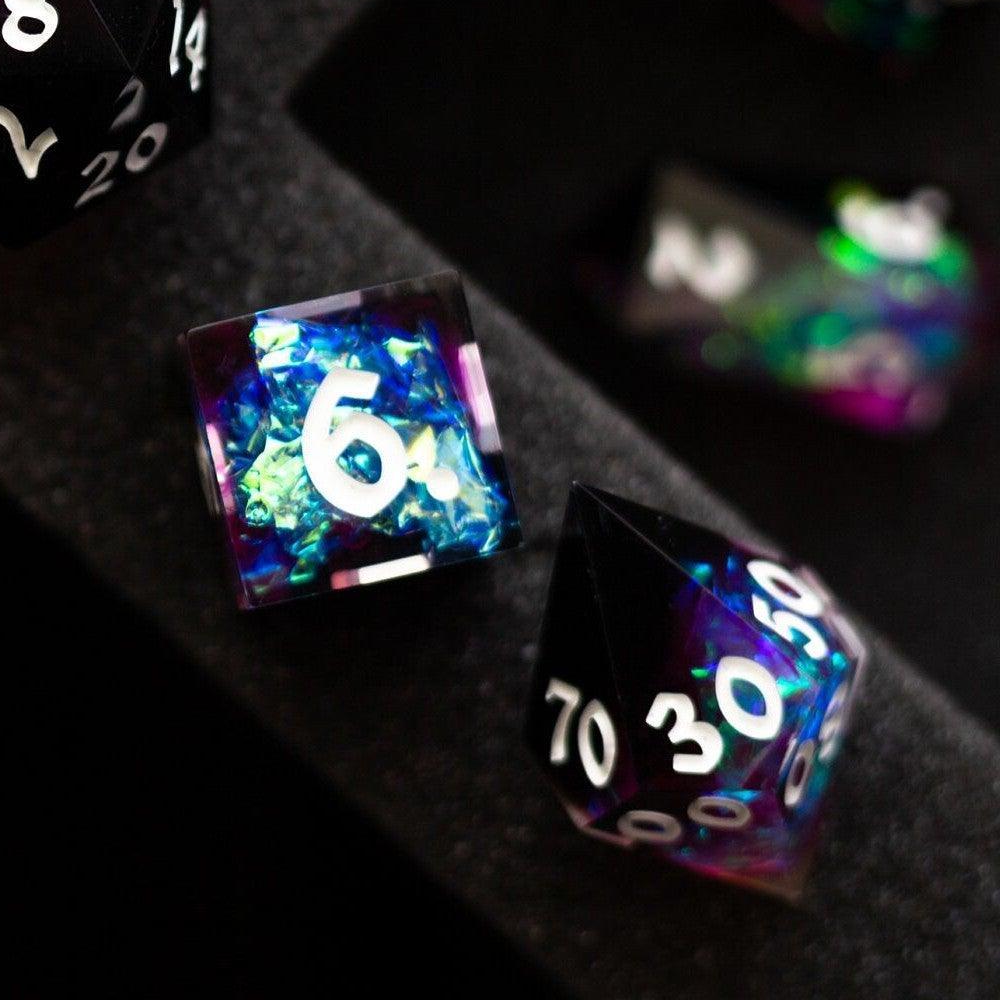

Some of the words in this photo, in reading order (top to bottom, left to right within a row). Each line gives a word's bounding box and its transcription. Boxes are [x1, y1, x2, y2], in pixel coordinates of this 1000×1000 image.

[73, 121, 169, 210] 20
[746, 559, 830, 660] 50
[544, 677, 618, 789] 70
[645, 654, 784, 776] 30
